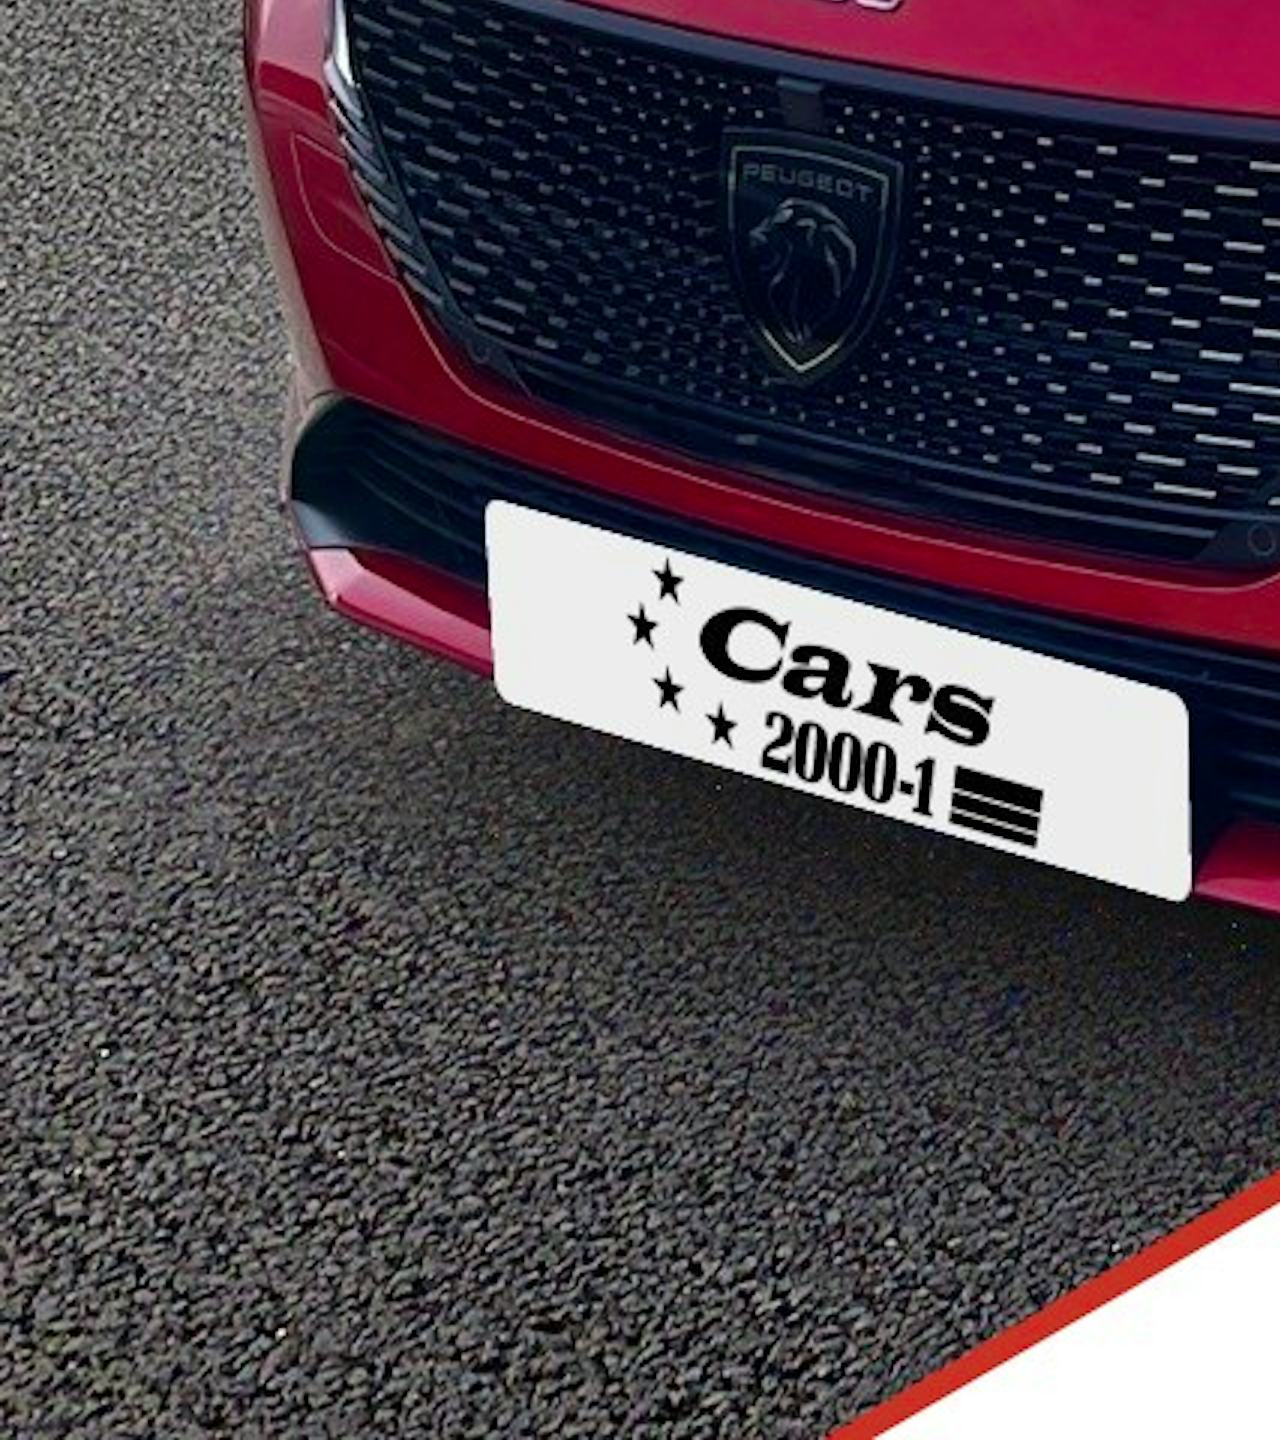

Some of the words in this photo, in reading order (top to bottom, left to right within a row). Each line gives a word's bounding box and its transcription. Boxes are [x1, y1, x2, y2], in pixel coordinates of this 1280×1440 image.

[743, 163, 873, 202] PEUGEOT
[699, 607, 994, 747] Cars
[761, 711, 936, 817] 2000-1
